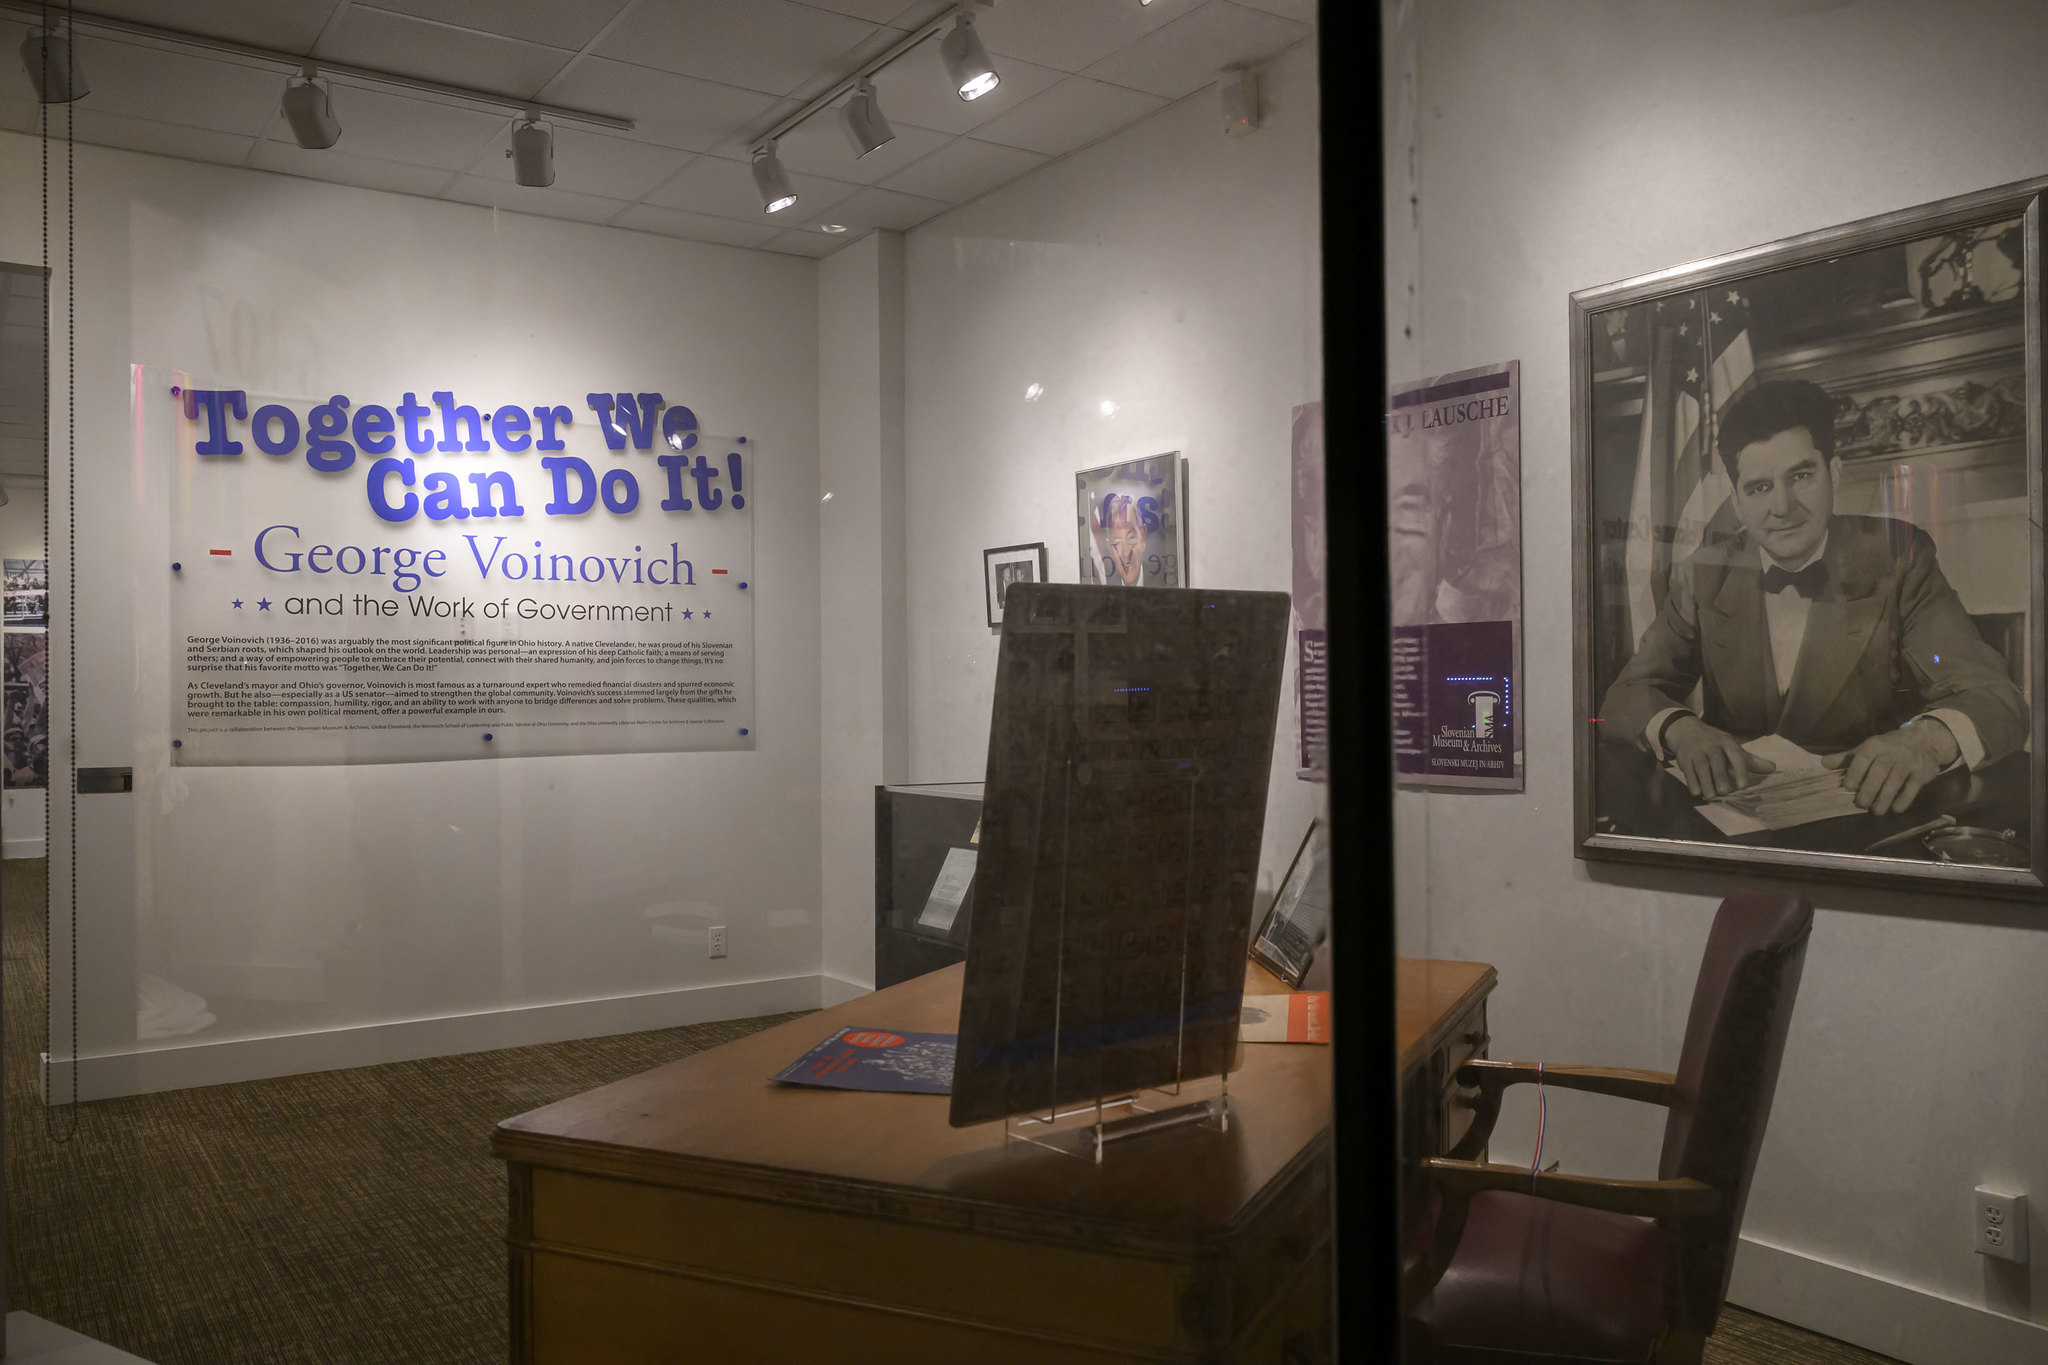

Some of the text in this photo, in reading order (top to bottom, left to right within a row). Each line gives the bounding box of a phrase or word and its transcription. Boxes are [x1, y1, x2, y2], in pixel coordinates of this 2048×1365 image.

[1423, 396, 1510, 430] LAUSCHE
[184, 389, 698, 473] Together We
[367, 453, 747, 522] Can Do It!
[254, 524, 696, 593] George Voinovich
[285, 594, 673, 622] and the Work of Government
[187, 635, 220, 645] George
[222, 635, 265, 644] Voinovich
[338, 637, 375, 647] arguably
[376, 637, 390, 645] the
[413, 638, 453, 648] significant
[453, 638, 485, 648] political
[486, 638, 509, 648] figure
[537, 639, 564, 649] history.
[594, 640, 637, 648] Clevelander,
[662, 641, 682, 650] proud
[702, 641, 733, 649] Slovenian
[187, 644, 205, 652] and
[206, 644, 240, 653] Serbian
[242, 646, 267, 654] roots,
[268, 645, 294, 653] which
[296, 645, 327, 655] shaped
[342, 646, 374, 654] outlook
[388, 646, 401, 654] the
[402, 646, 427, 654] world.
[428, 647, 471, 656] Leadership
[539, 648, 577, 657] expression
[598, 648, 617, 657] deep
[617, 648, 645, 656] Catholic
[701, 650, 725, 658] serving
[220, 654, 237, 662] and
[246, 656, 264, 664] way
[276, 655, 330, 664] empowering
[331, 654, 360, 664] people
[428, 655, 465, 665] potential,
[560, 656, 596, 665] humanity,
[611, 657, 625, 665] join
[626, 656, 646, 664] forces
[656, 656, 680, 666] change
[681, 657, 703, 666] things.
[187, 664, 223, 673] surprise
[225, 663, 243, 671] that
[259, 663, 292, 671] favorite
[382, 662, 395, 671] We
[396, 662, 412, 671] Can
[413, 662, 425, 671] Do
[187, 681, 199, 689] As
[280, 681, 297, 689] and
[326, 683, 366, 691] governor,
[526, 682, 550, 690] expert
[678, 680, 703, 689] spurred
[187, 690, 222, 701] growth.
[224, 690, 239, 698] But
[430, 689, 473, 699] strengthen
[488, 689, 512, 698] global
[513, 689, 556, 698] community.
[623, 688, 655, 696] stemmed
[656, 688, 679, 697] largely
[708, 688, 723, 697] gifts
[187, 700, 224, 710] brought
[237, 699, 252, 707] the
[254, 699, 278, 707] table:
[280, 699, 332, 709] compassion,
[334, 698, 370, 708] humility,
[371, 699, 393, 708] rigor,
[394, 698, 410, 706] and
[422, 698, 447, 708] ability
[478, 697, 495, 705] with
[496, 699, 524, 707] anyone
[534, 697, 558, 706] bridge
[559, 696, 598, 704] differences
[599, 696, 613, 704] and
[613, 696, 632, 704] solve
[632, 696, 666, 705] problems.
[687, 696, 716, 705] qualities,
[211, 708, 262, 717] remarkable
[308, 708, 341, 718] political
[343, 708, 380, 716] moment,
[381, 707, 400, 715] offer
[408, 706, 444, 716] powerful
[444, 706, 477, 716] example
[1441, 725, 1475, 738] Slovenian
[1433, 735, 1502, 753] Museum & Archives
[1431, 758, 1460, 767] SLOVENSKI
[1460, 759, 1478, 770] MUZEJ
